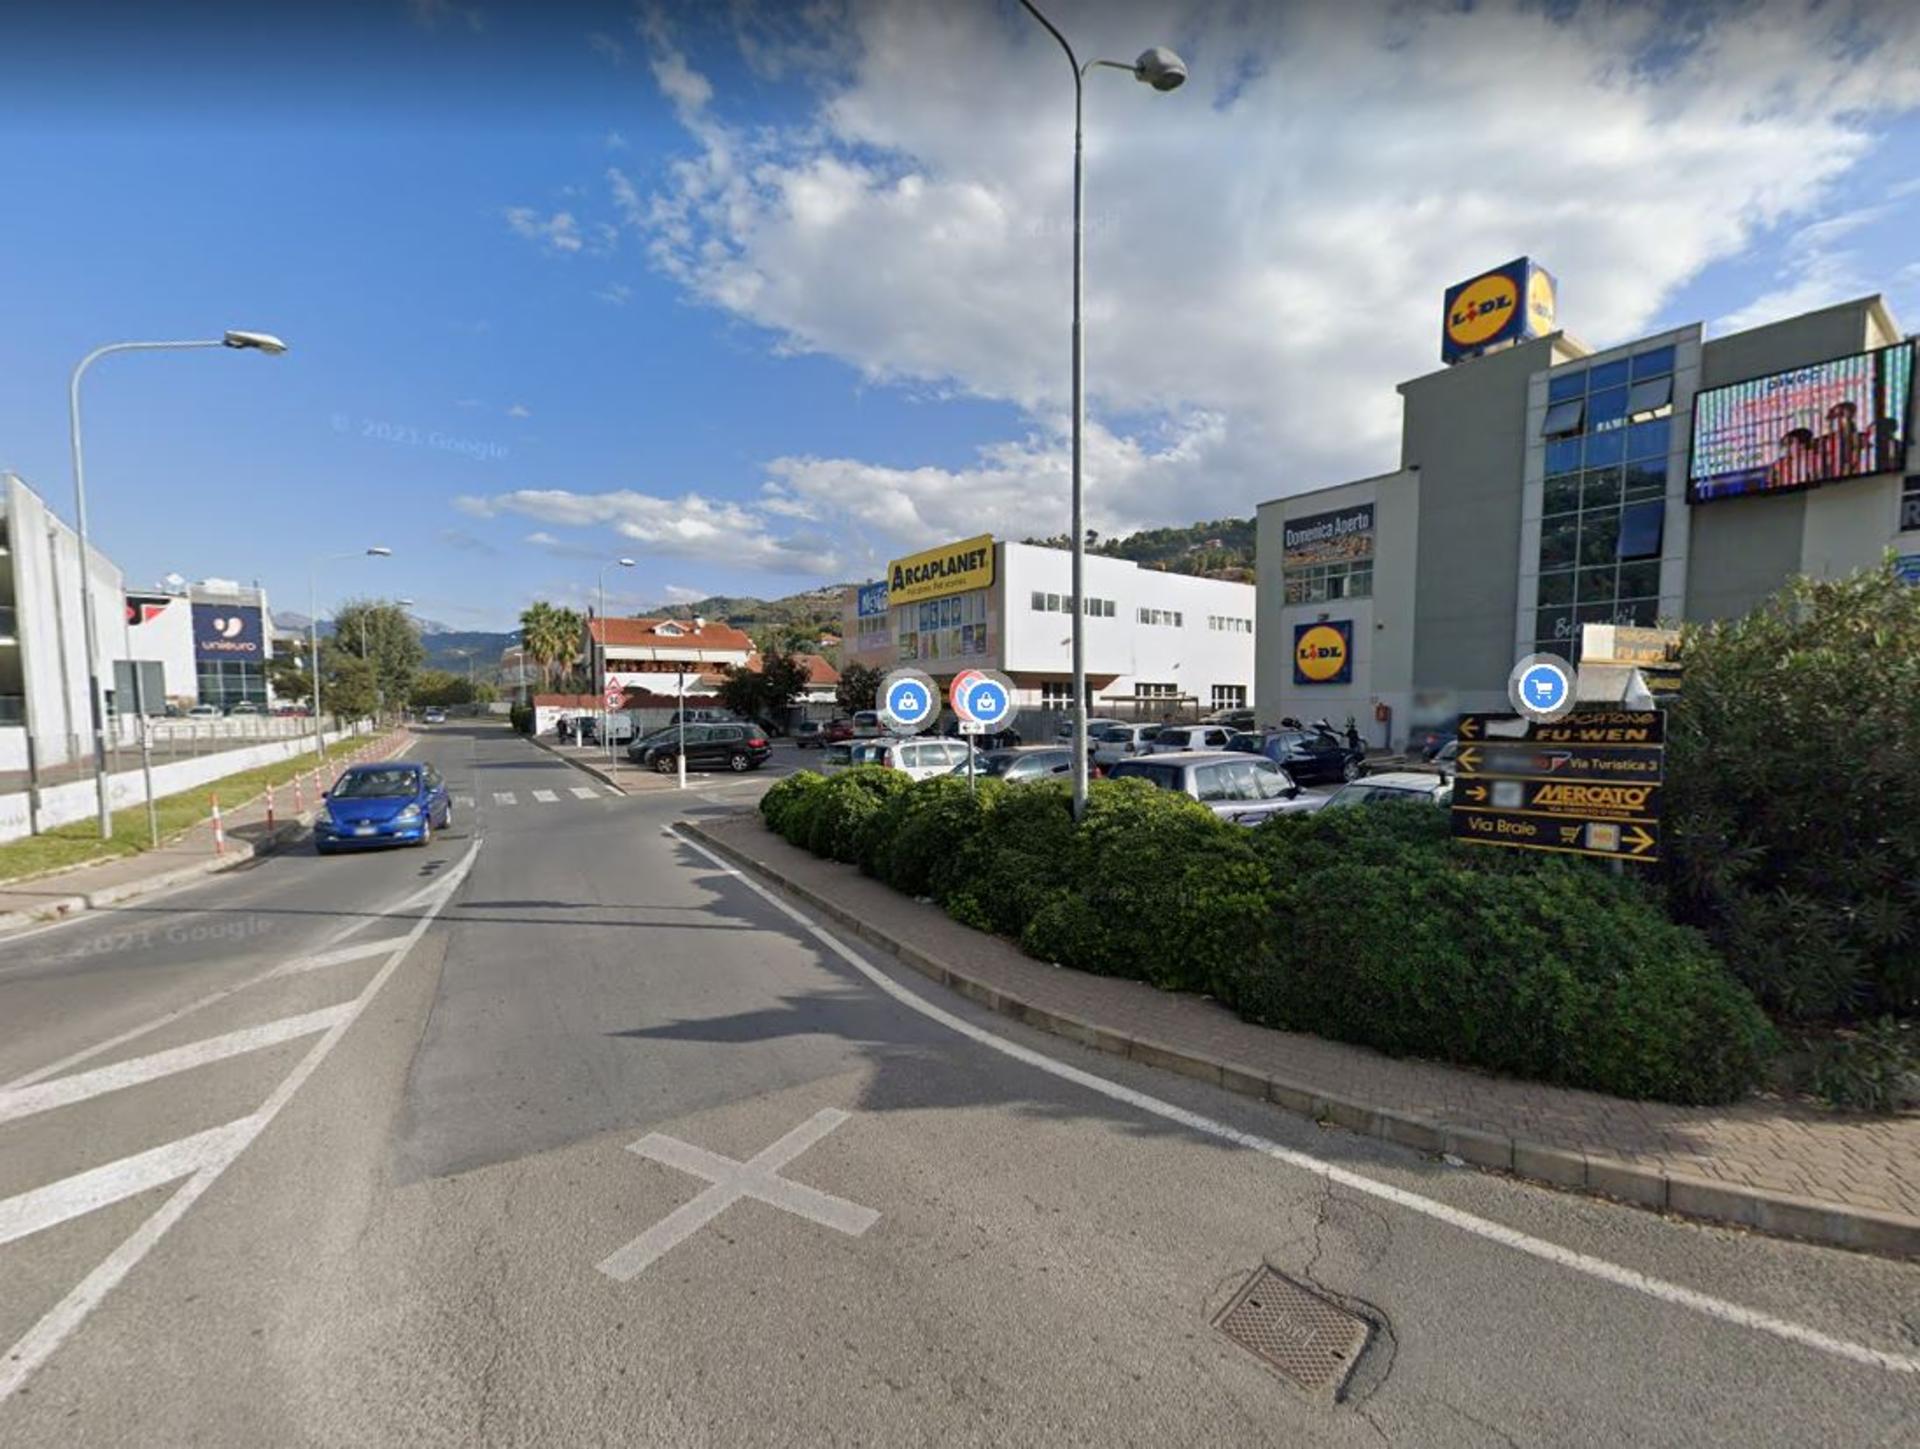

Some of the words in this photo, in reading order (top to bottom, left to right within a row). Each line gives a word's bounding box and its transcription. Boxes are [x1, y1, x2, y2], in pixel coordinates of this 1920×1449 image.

[892, 547, 987, 592] ARCAPLANET
[201, 640, 257, 651] unieuro
[1535, 728, 1648, 741] FU-WEN
[1570, 758, 1589, 769] Via
[1591, 758, 1646, 772] Turistica
[1468, 816, 1493, 832] Via
